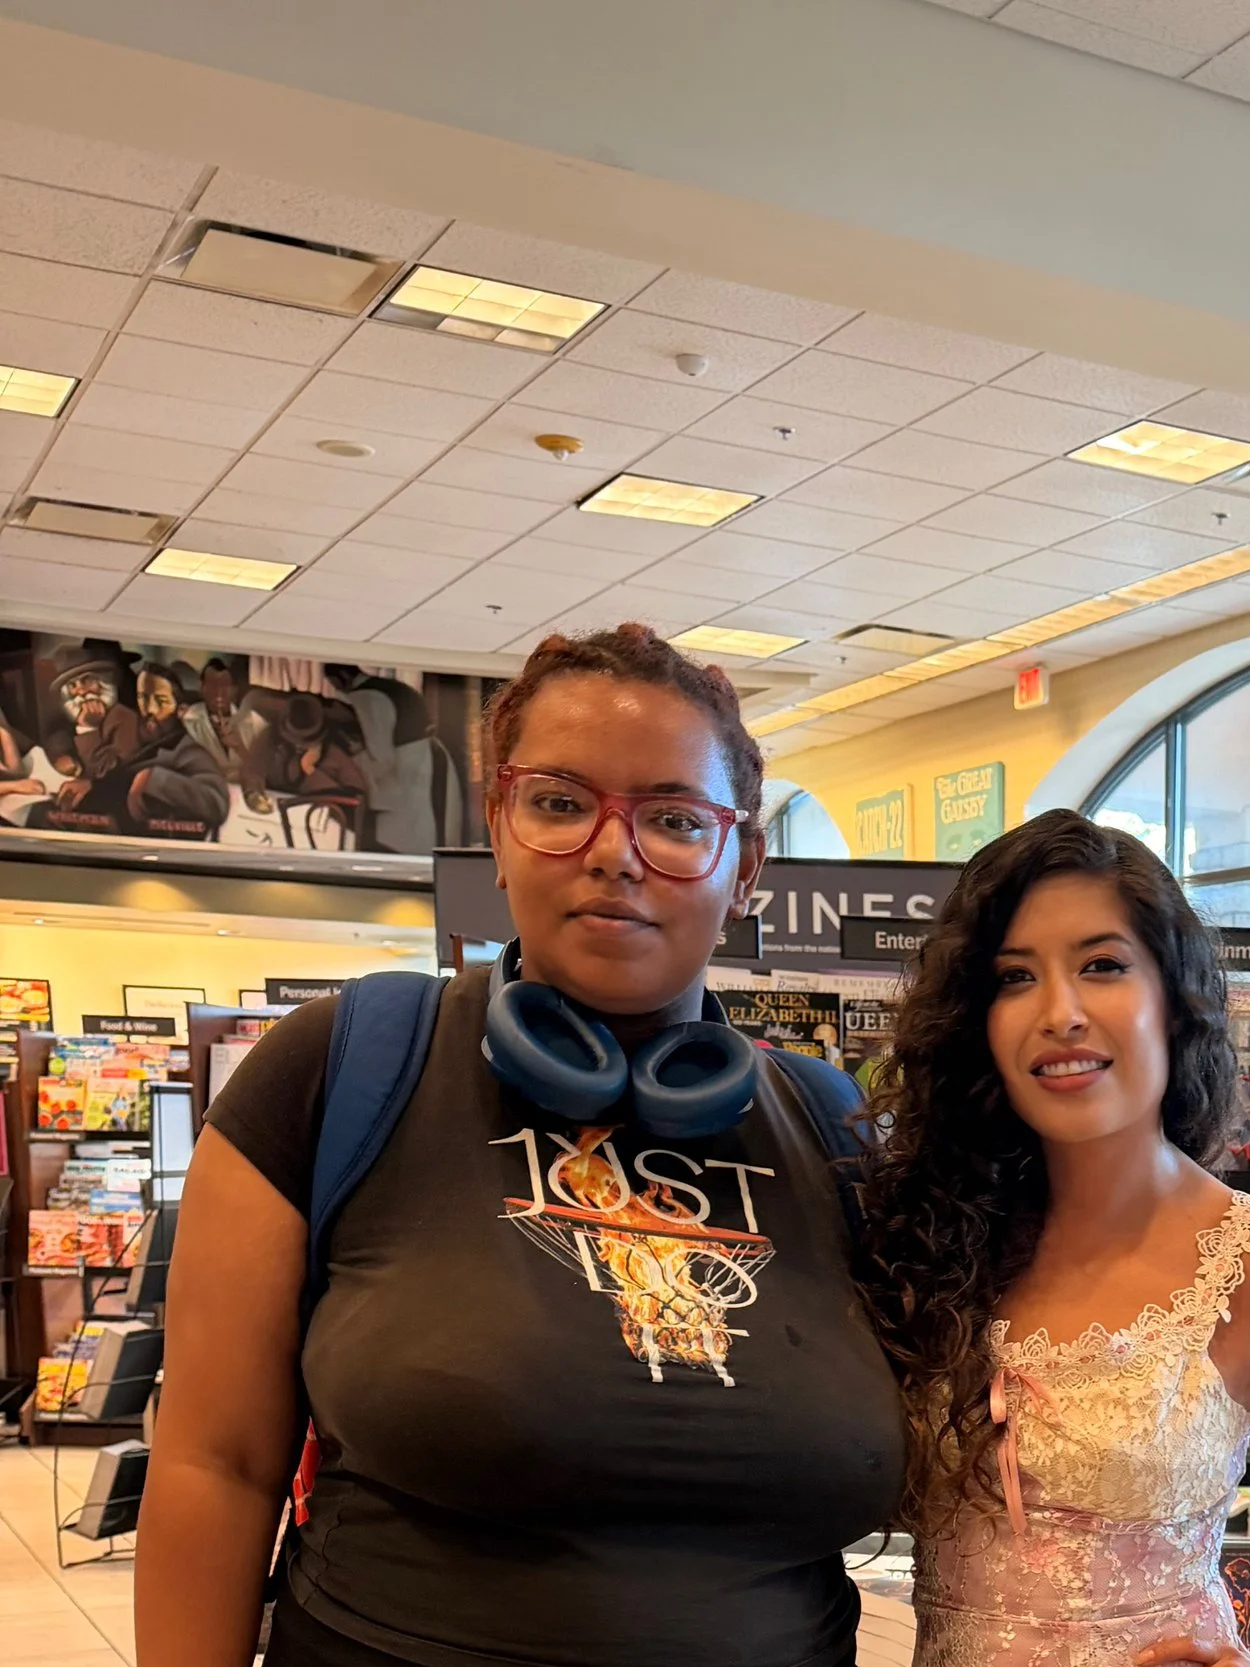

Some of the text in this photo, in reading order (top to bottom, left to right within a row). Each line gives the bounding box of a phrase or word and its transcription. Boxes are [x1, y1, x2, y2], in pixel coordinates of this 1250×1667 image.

[957, 767, 993, 797] GREAT
[941, 794, 988, 825] GATSBY
[280, 986, 332, 999] Personal
[755, 993, 810, 1009] QUEEN
[729, 1008, 822, 1024] ELIZABETH
[100, 1020, 122, 1031] Food
[134, 1022, 158, 1032] Wine
[488, 1128, 776, 1234] JUST
